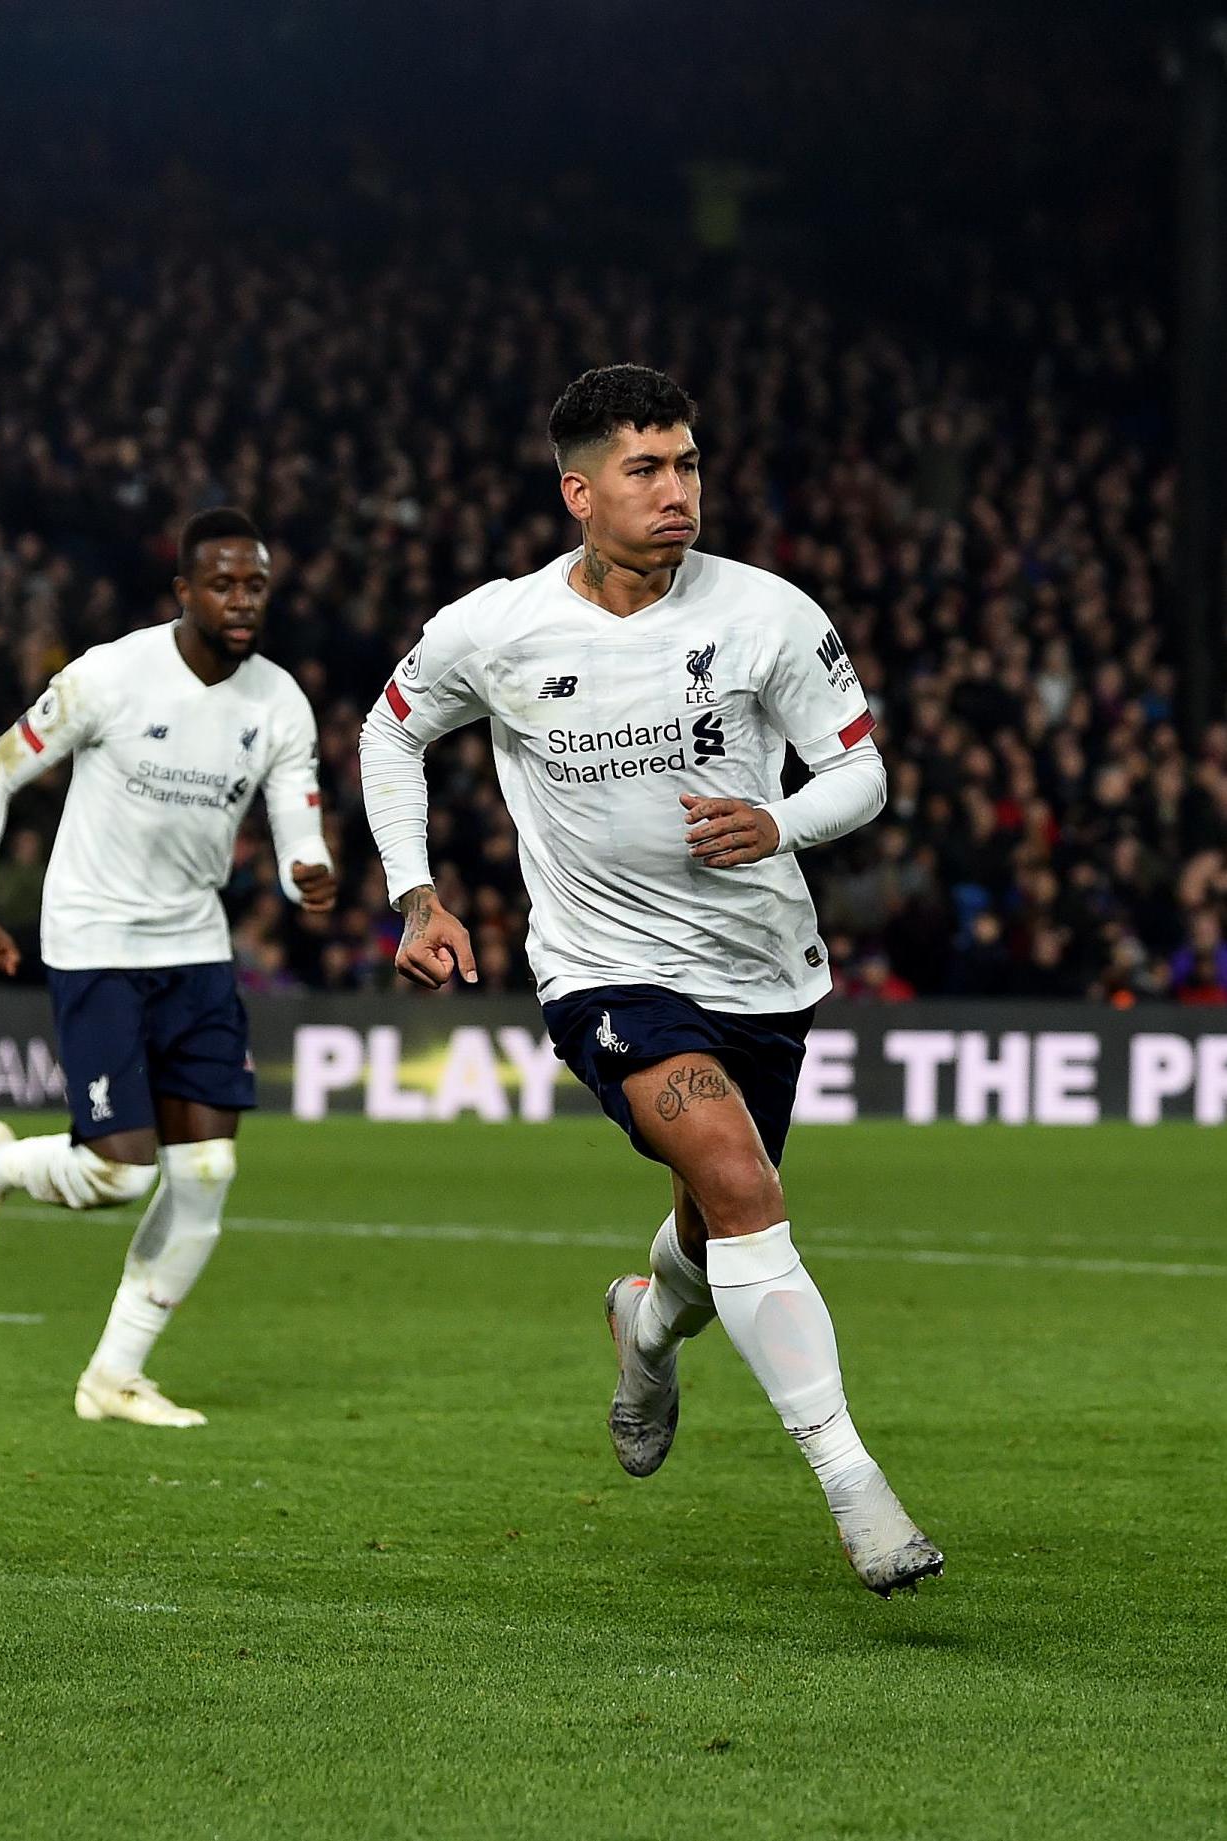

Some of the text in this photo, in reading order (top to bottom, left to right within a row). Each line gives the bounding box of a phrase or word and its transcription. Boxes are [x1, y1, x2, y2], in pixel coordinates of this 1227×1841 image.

[548, 717, 682, 755] Standard
[136, 760, 227, 788] Standard
[545, 747, 686, 784] Chartered
[126, 777, 220, 808] Chartered
[292, 1024, 566, 1122] PLAY
[883, 1030, 1099, 1125] THE
